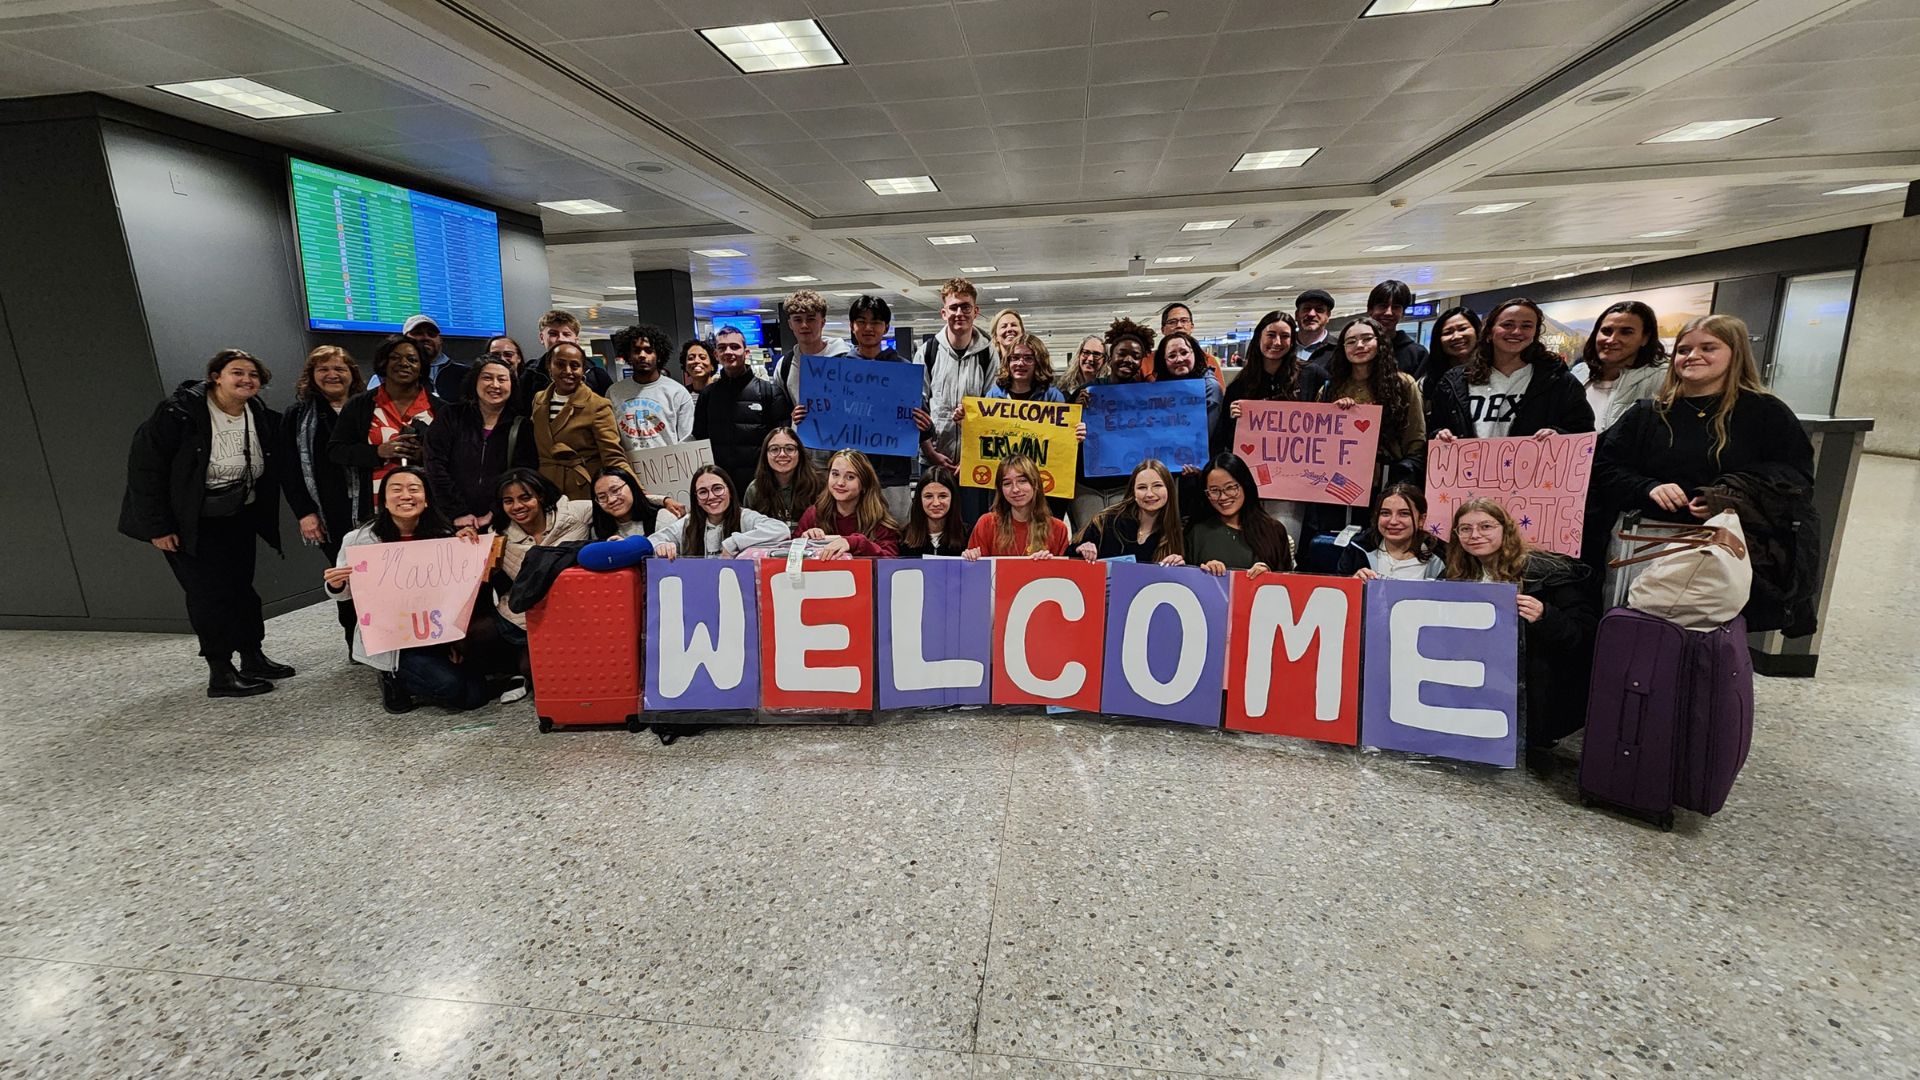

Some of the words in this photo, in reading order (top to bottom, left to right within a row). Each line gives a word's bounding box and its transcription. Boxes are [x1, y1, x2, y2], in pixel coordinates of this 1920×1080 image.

[807, 358, 890, 388] Welcome
[806, 398, 831, 414] RED
[896, 406, 914, 420] BLU
[977, 400, 1071, 428] WELCOME
[1248, 410, 1348, 436] WELCOME
[619, 419, 666, 437] MARYLAND
[813, 418, 898, 449] William
[632, 446, 710, 485] ENVENUE
[978, 435, 1050, 467] ERWAN
[1261, 436, 1327, 465] LUCIE
[1338, 439, 1358, 466] F.
[1428, 435, 1593, 493] WELCOME
[411, 609, 444, 641] US
[658, 567, 1509, 739] WELCOME
